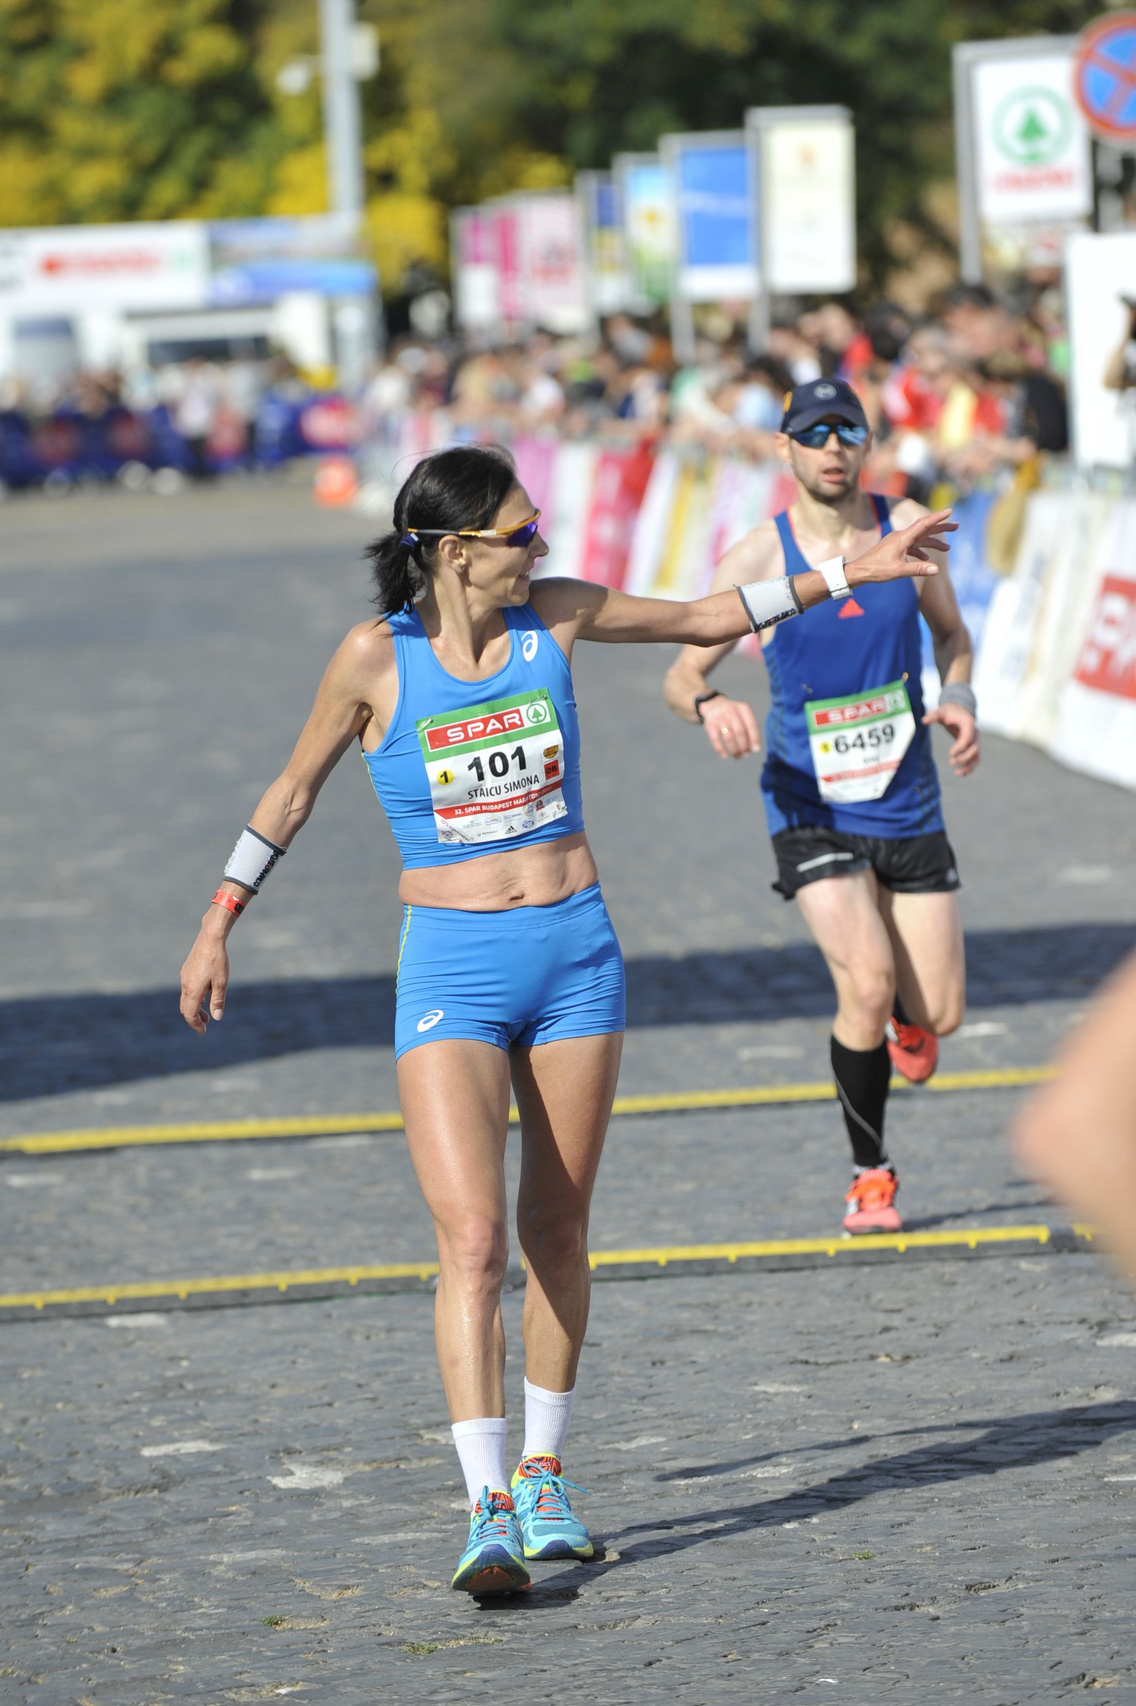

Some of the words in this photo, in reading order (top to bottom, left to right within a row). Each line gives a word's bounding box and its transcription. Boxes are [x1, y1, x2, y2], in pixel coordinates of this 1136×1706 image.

[446, 712, 522, 742] SPAR
[834, 724, 895, 754] 6459
[439, 770, 449, 784] 1
[467, 745, 527, 783] 101
[467, 785, 502, 800] STAICU
[504, 774, 540, 794] SIMONA
[464, 805, 481, 815] SPAR
[482, 800, 512, 812] BUDAPEST
